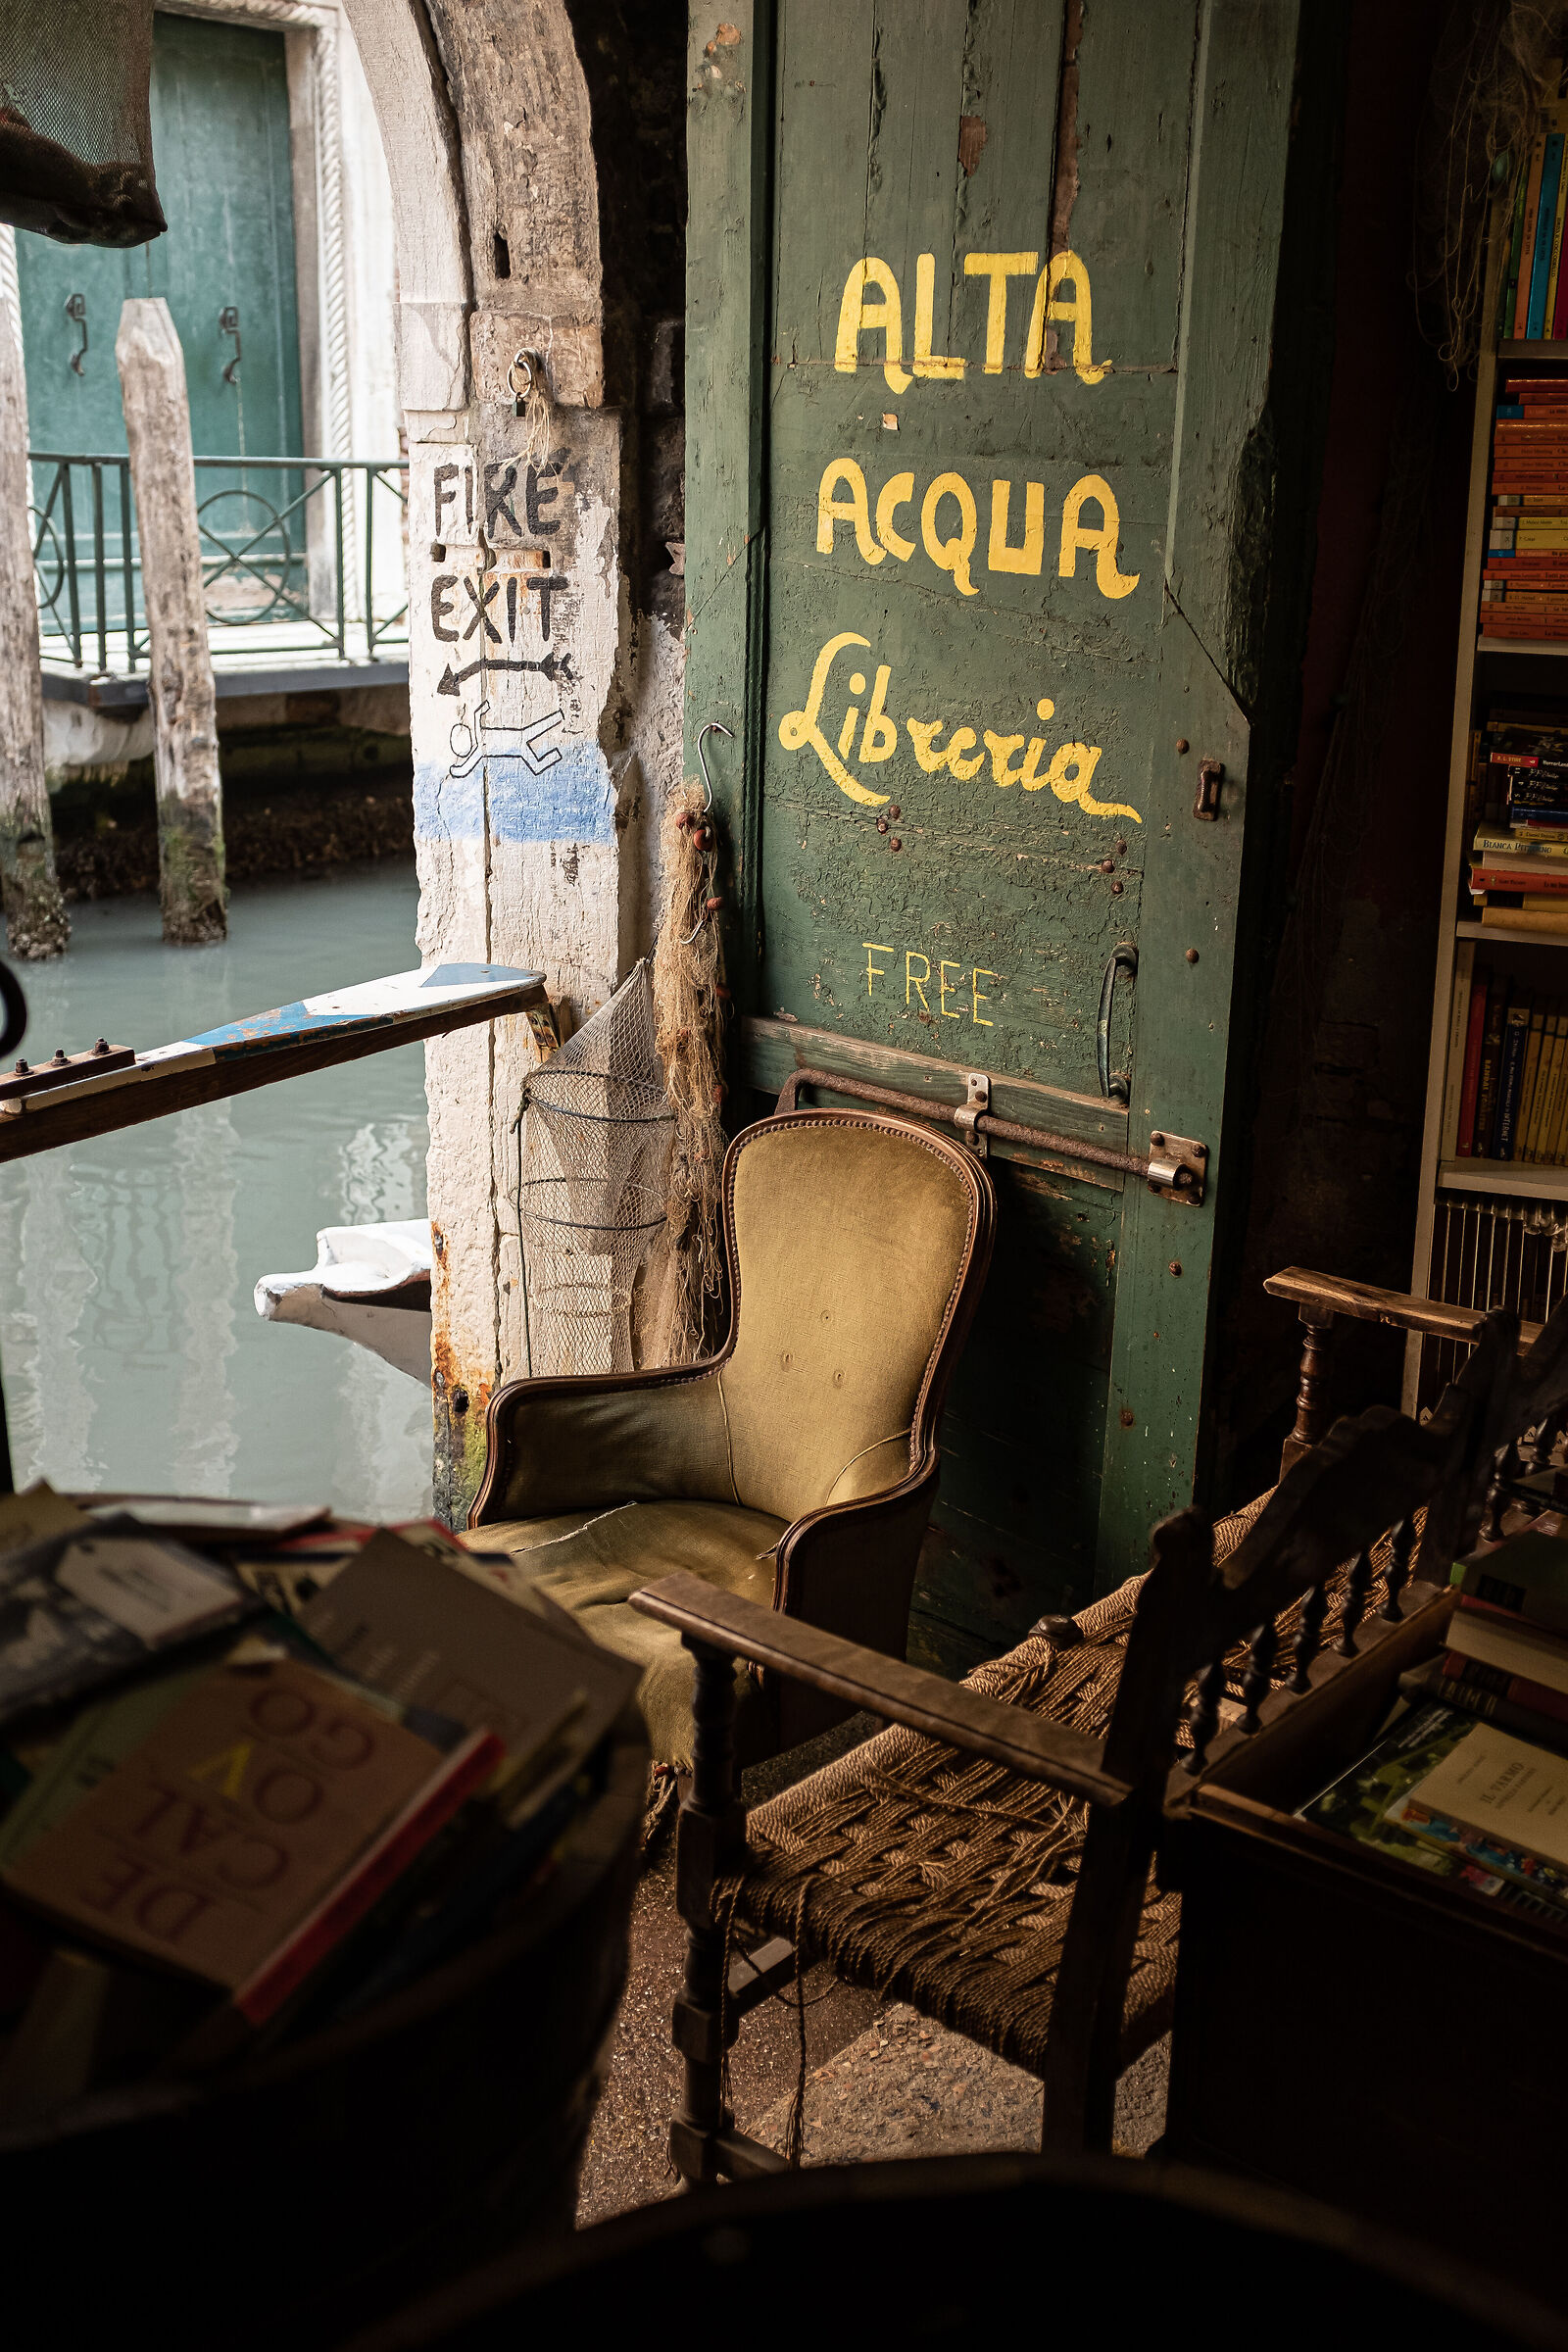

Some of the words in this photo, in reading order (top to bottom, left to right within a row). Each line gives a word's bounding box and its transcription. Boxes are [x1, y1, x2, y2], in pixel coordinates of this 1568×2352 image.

[834, 250, 1113, 394] ALTA
[433, 455, 564, 538] FIRE
[816, 457, 1140, 600] ACQUA
[431, 574, 568, 644] EXIT
[778, 631, 1143, 824] Libreria
[1483, 839, 1512, 851] BIANCA
[861, 942, 995, 1027] FREE
